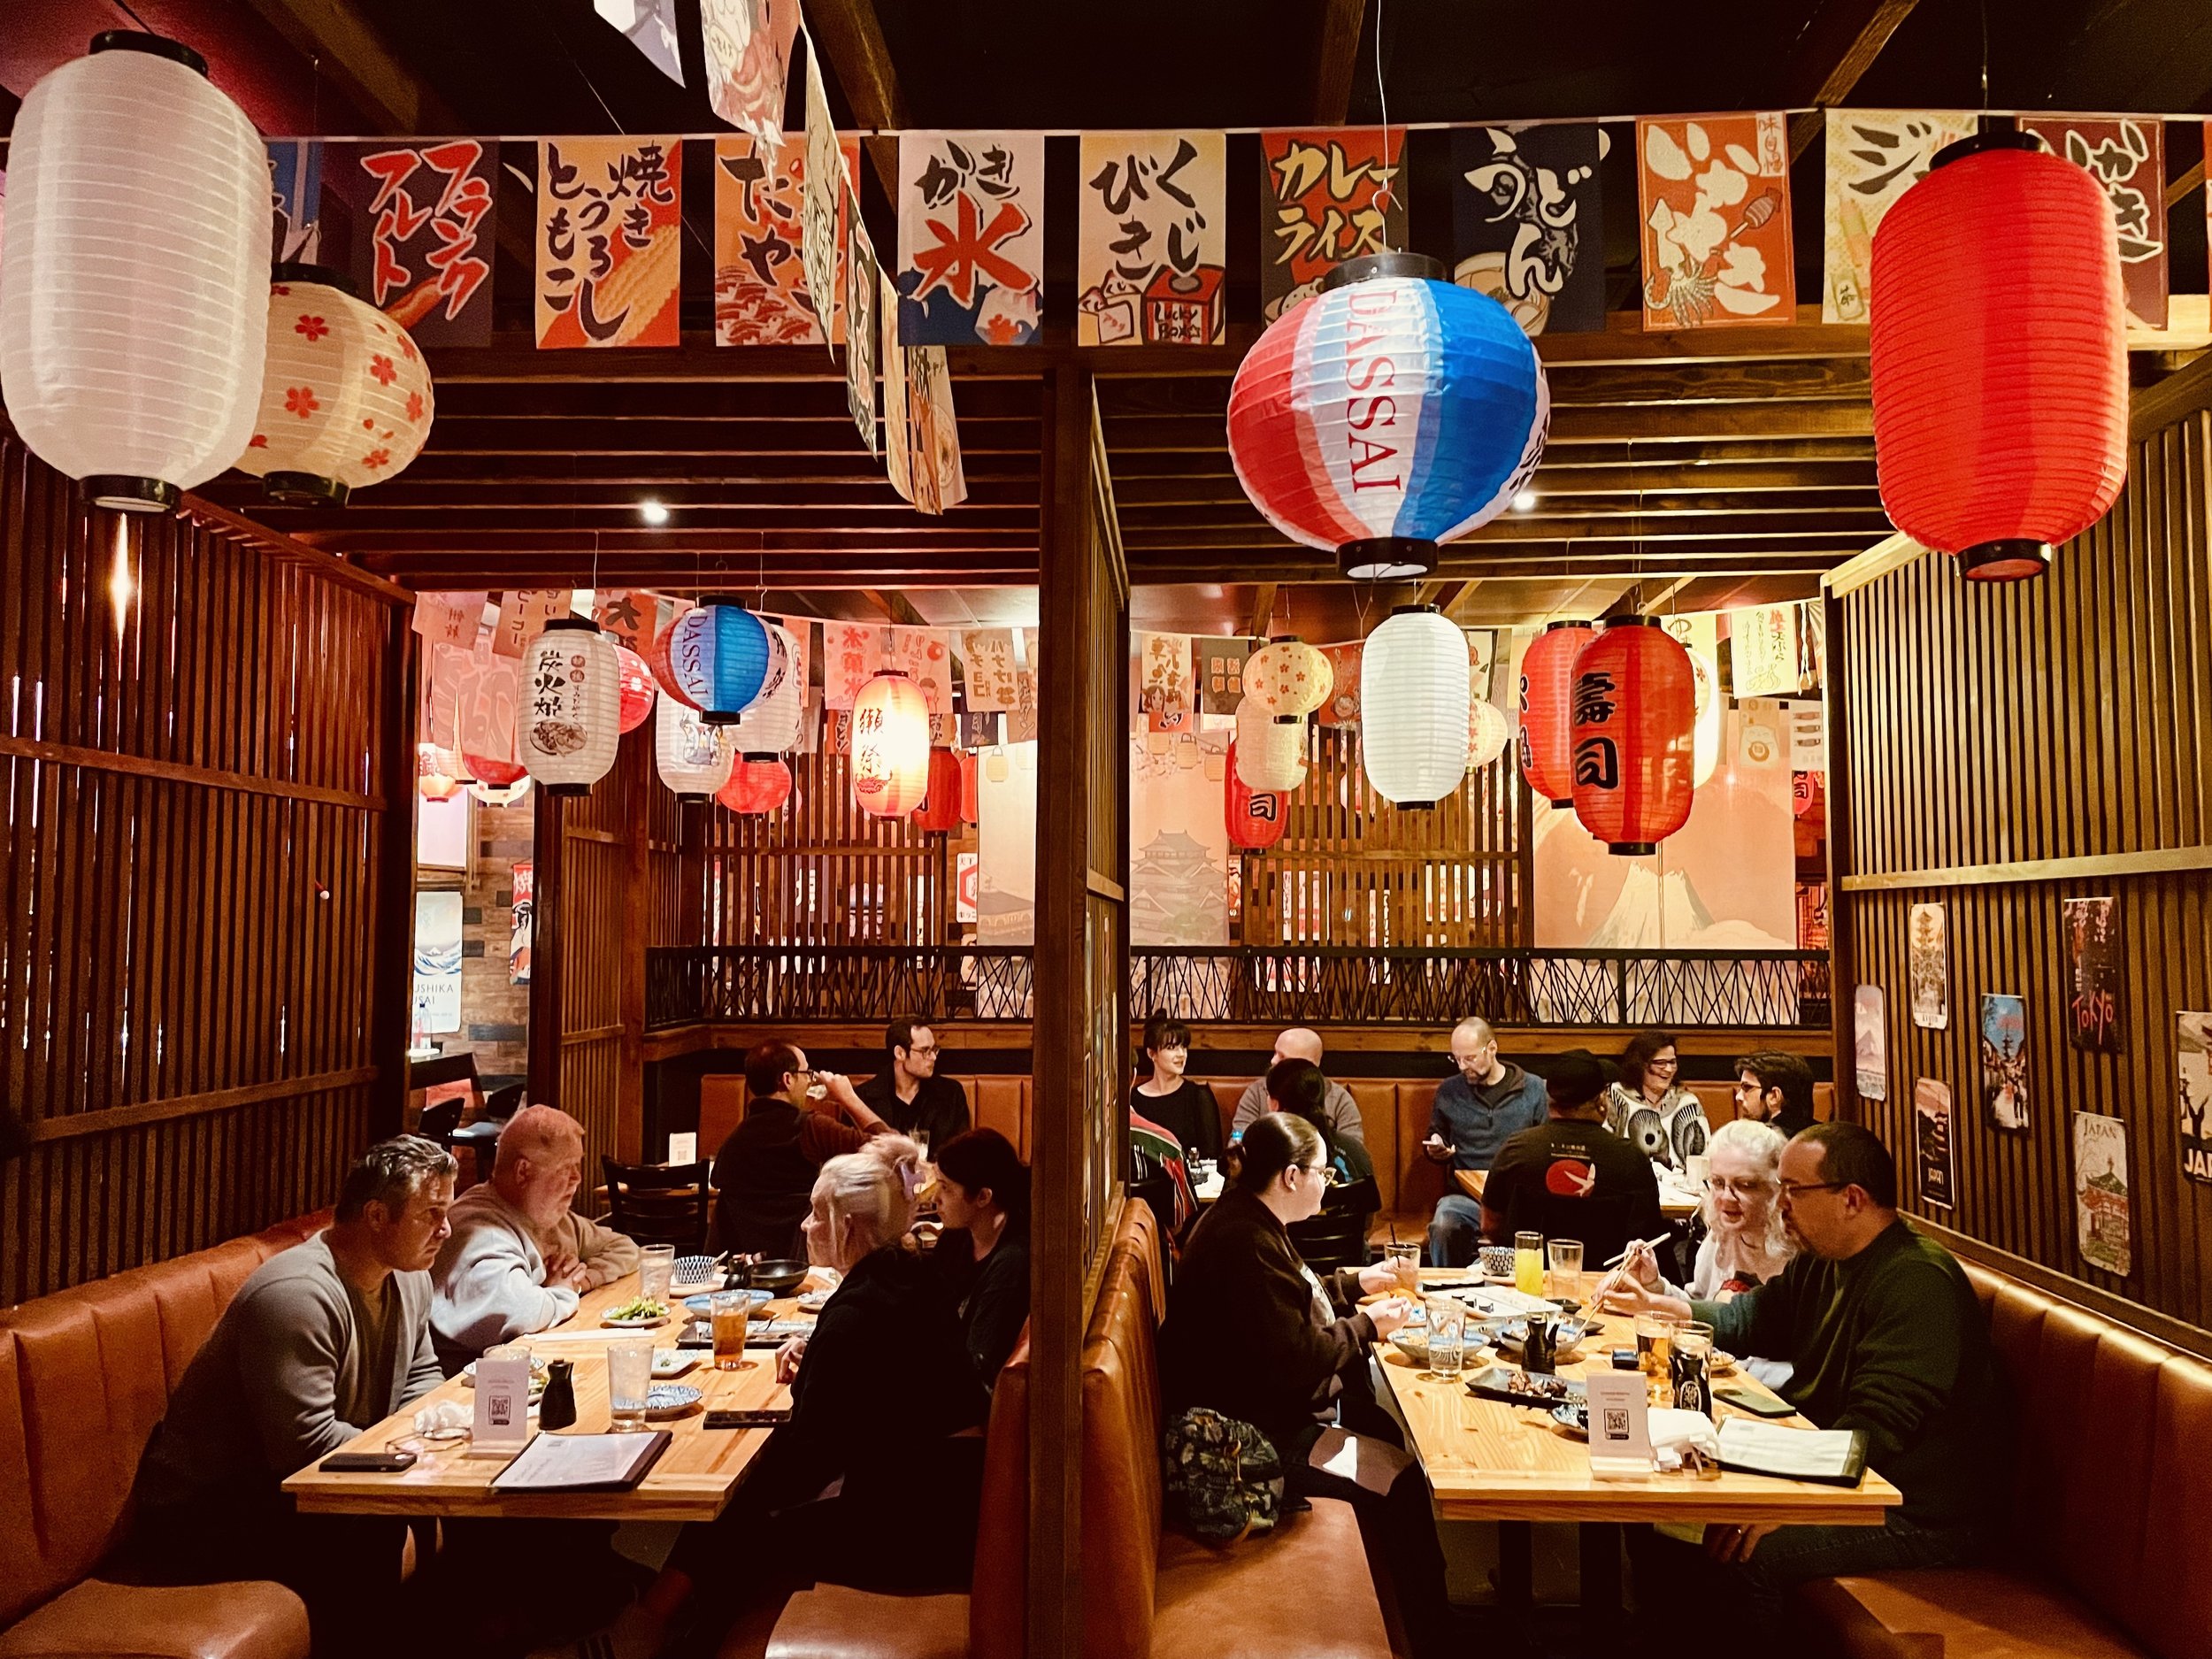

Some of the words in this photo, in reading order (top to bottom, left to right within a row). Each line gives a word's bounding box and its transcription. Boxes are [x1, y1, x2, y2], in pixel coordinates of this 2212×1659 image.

[360, 148, 433, 306] フルト
[420, 139, 489, 320] フランク
[607, 140, 673, 249] 焼き
[914, 139, 1010, 209] かき
[1089, 153, 1158, 280] びき
[1156, 138, 1206, 271] くじ
[1271, 142, 1399, 201] カレー
[914, 190, 1035, 308] 氷
[1274, 208, 1391, 265] ライス
[1346, 289, 1402, 493] DASSAI
[681, 615, 709, 695] DASSAI
